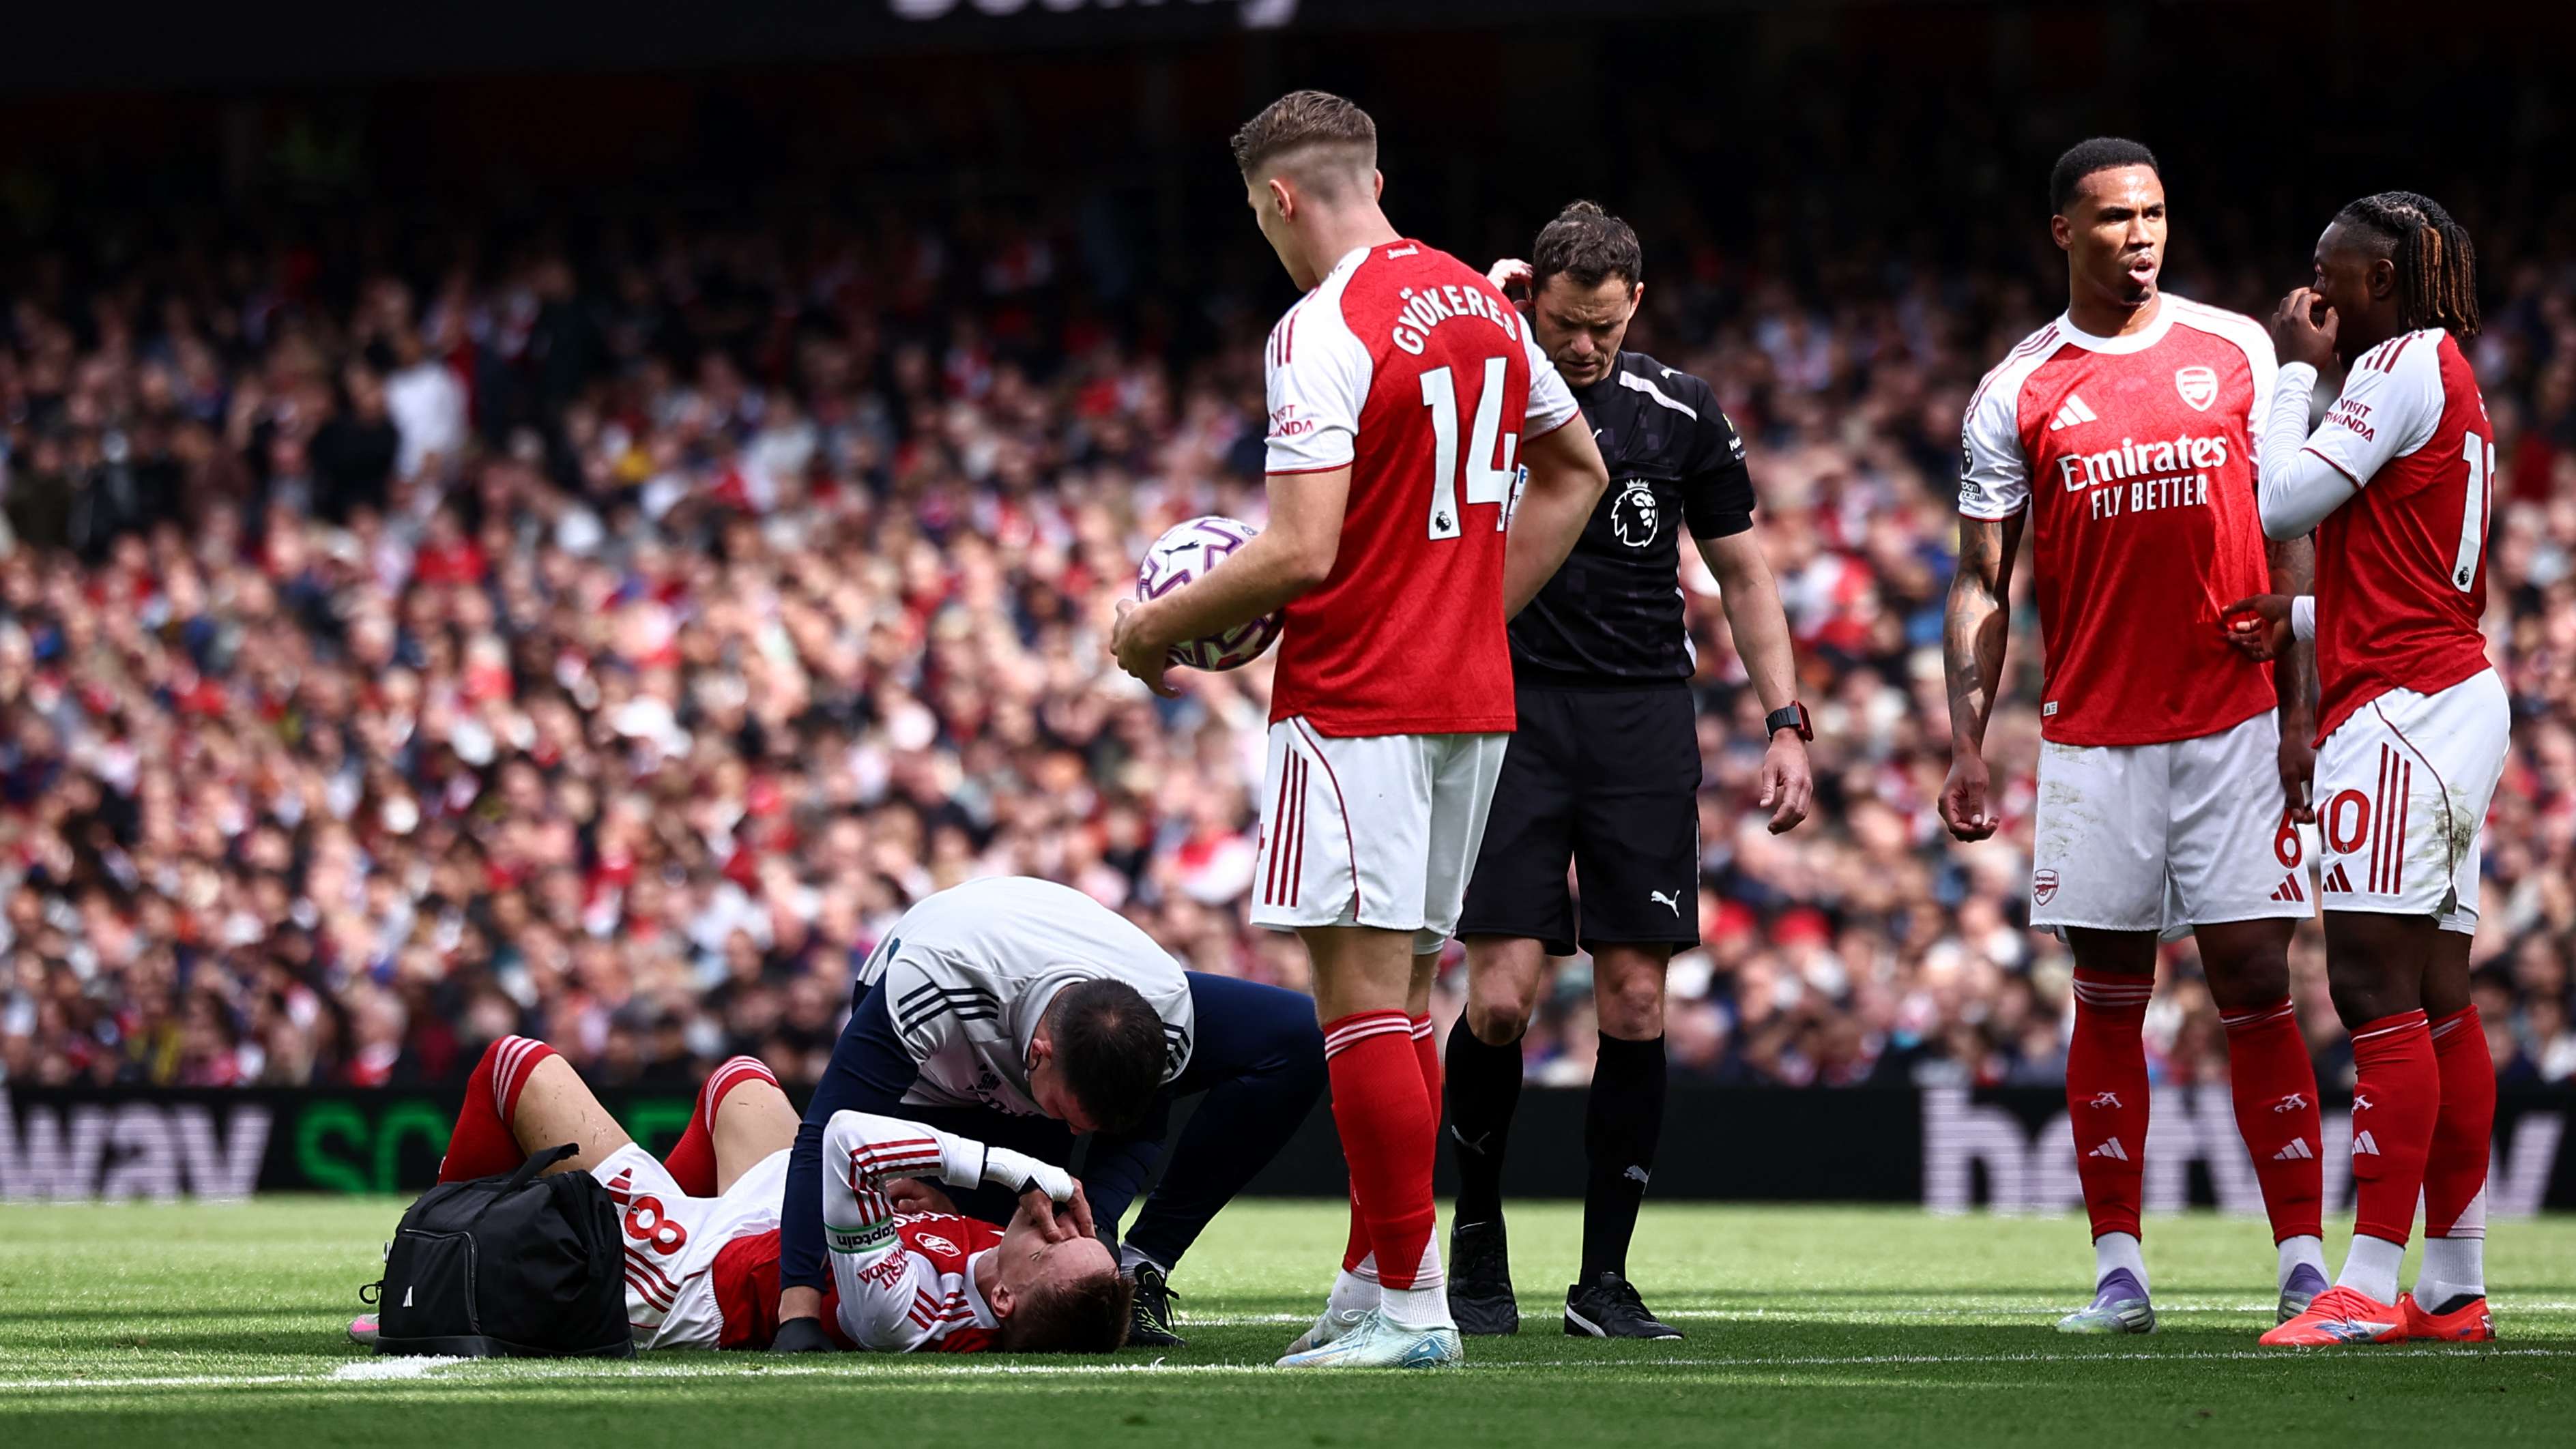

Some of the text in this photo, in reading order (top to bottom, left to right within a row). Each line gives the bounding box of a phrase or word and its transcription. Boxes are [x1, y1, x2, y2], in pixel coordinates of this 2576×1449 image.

[1392, 284, 1518, 355] GYÖKERES
[2341, 398, 2372, 419] VISIT
[1419, 356, 1518, 540] 14
[2056, 433, 2227, 493] Emirates
[2090, 473, 2208, 521] FLY BETTER
[2274, 806, 2302, 869] 6
[624, 1195, 688, 1256] 8
[836, 1222, 896, 1249] captain
